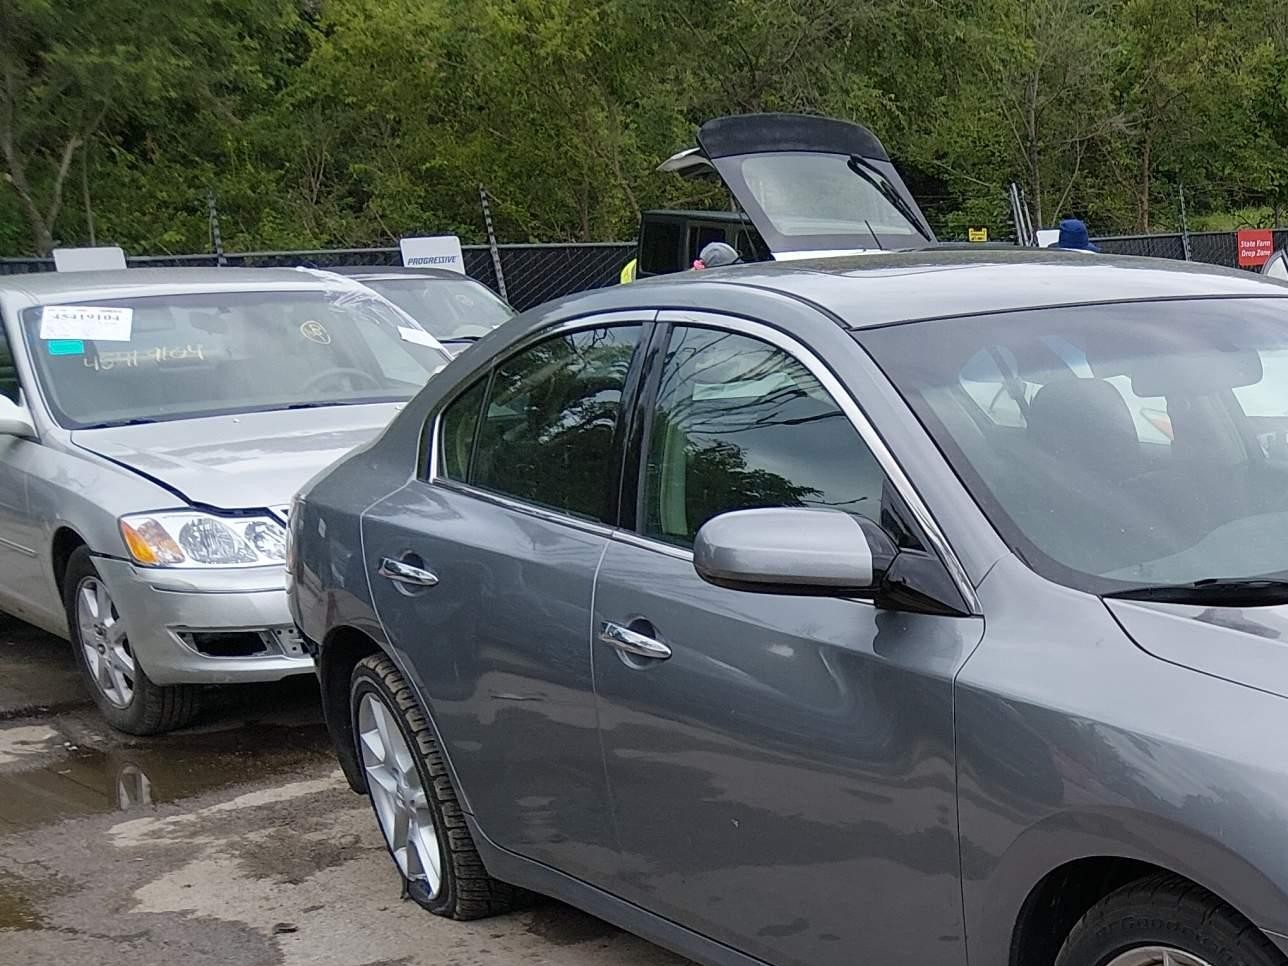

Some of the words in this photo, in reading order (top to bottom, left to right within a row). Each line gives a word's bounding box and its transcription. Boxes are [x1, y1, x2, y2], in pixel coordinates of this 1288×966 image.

[1240, 240, 1256, 248] State
[1241, 249, 1256, 257] Drop
[1256, 249, 1271, 257] Zone
[407, 255, 457, 266] PROGRESSIVE
